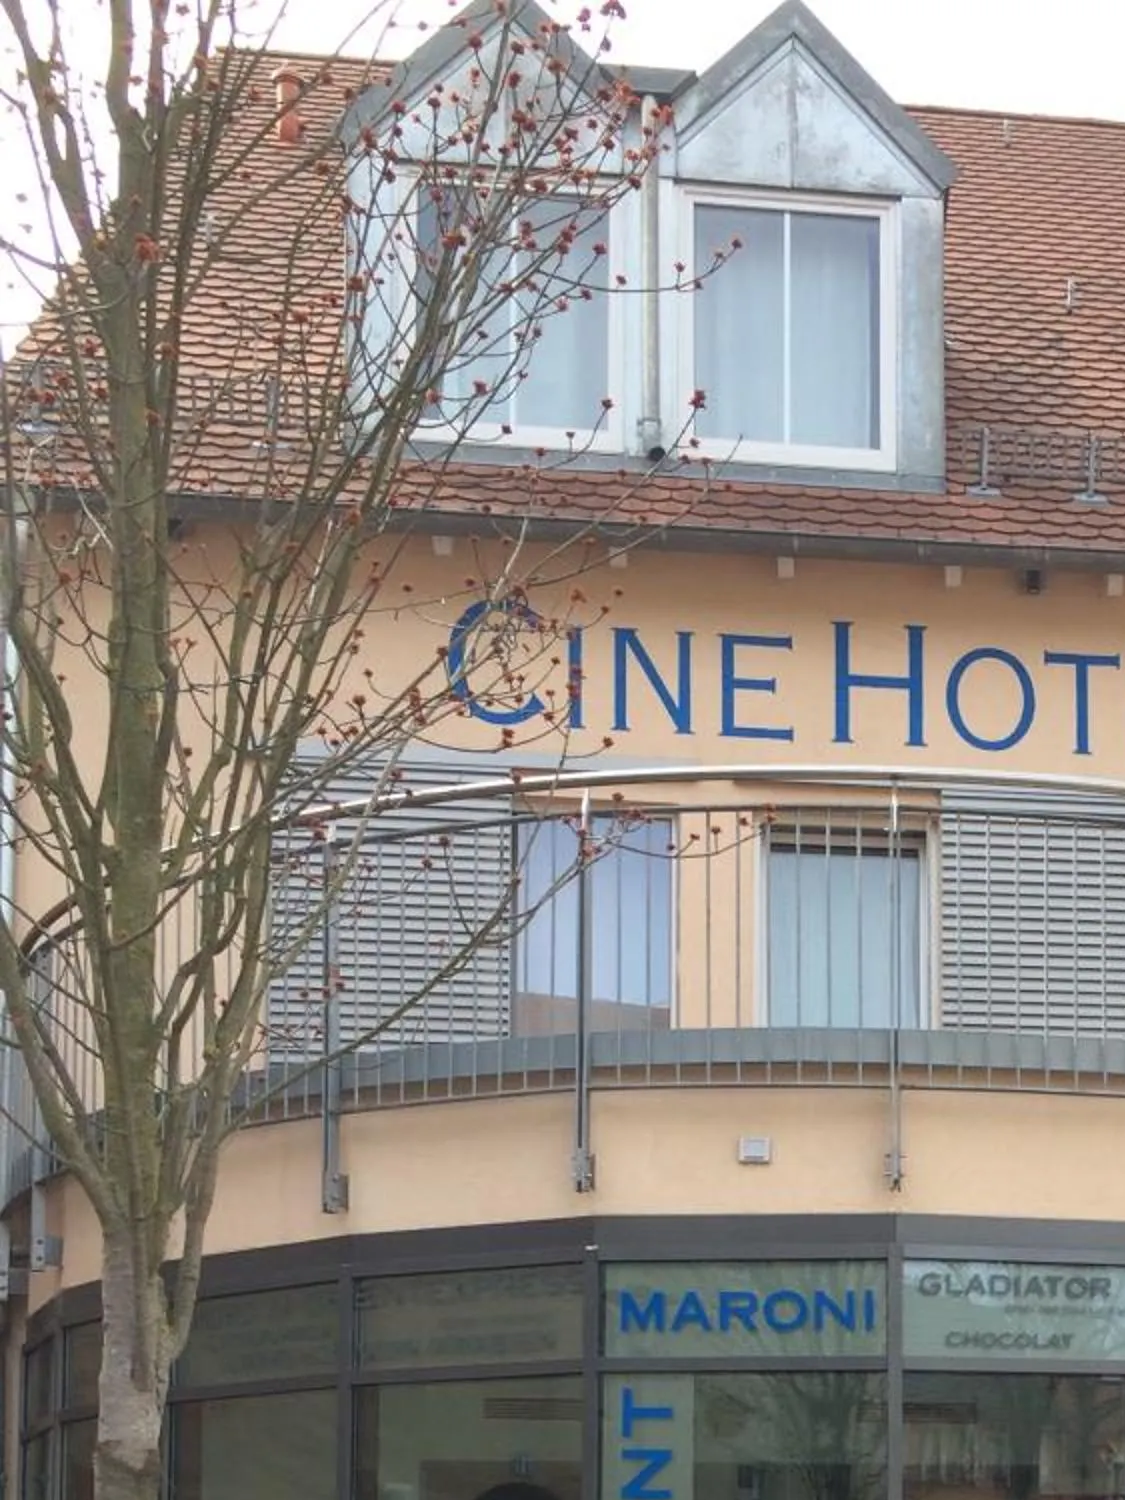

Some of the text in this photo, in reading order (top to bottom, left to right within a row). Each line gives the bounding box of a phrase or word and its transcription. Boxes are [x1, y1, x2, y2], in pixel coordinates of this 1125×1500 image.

[918, 1273, 1113, 1300] GLADIATOR
[618, 1288, 876, 1334] MARONI
[945, 1331, 1076, 1350] CHOCOLAT
